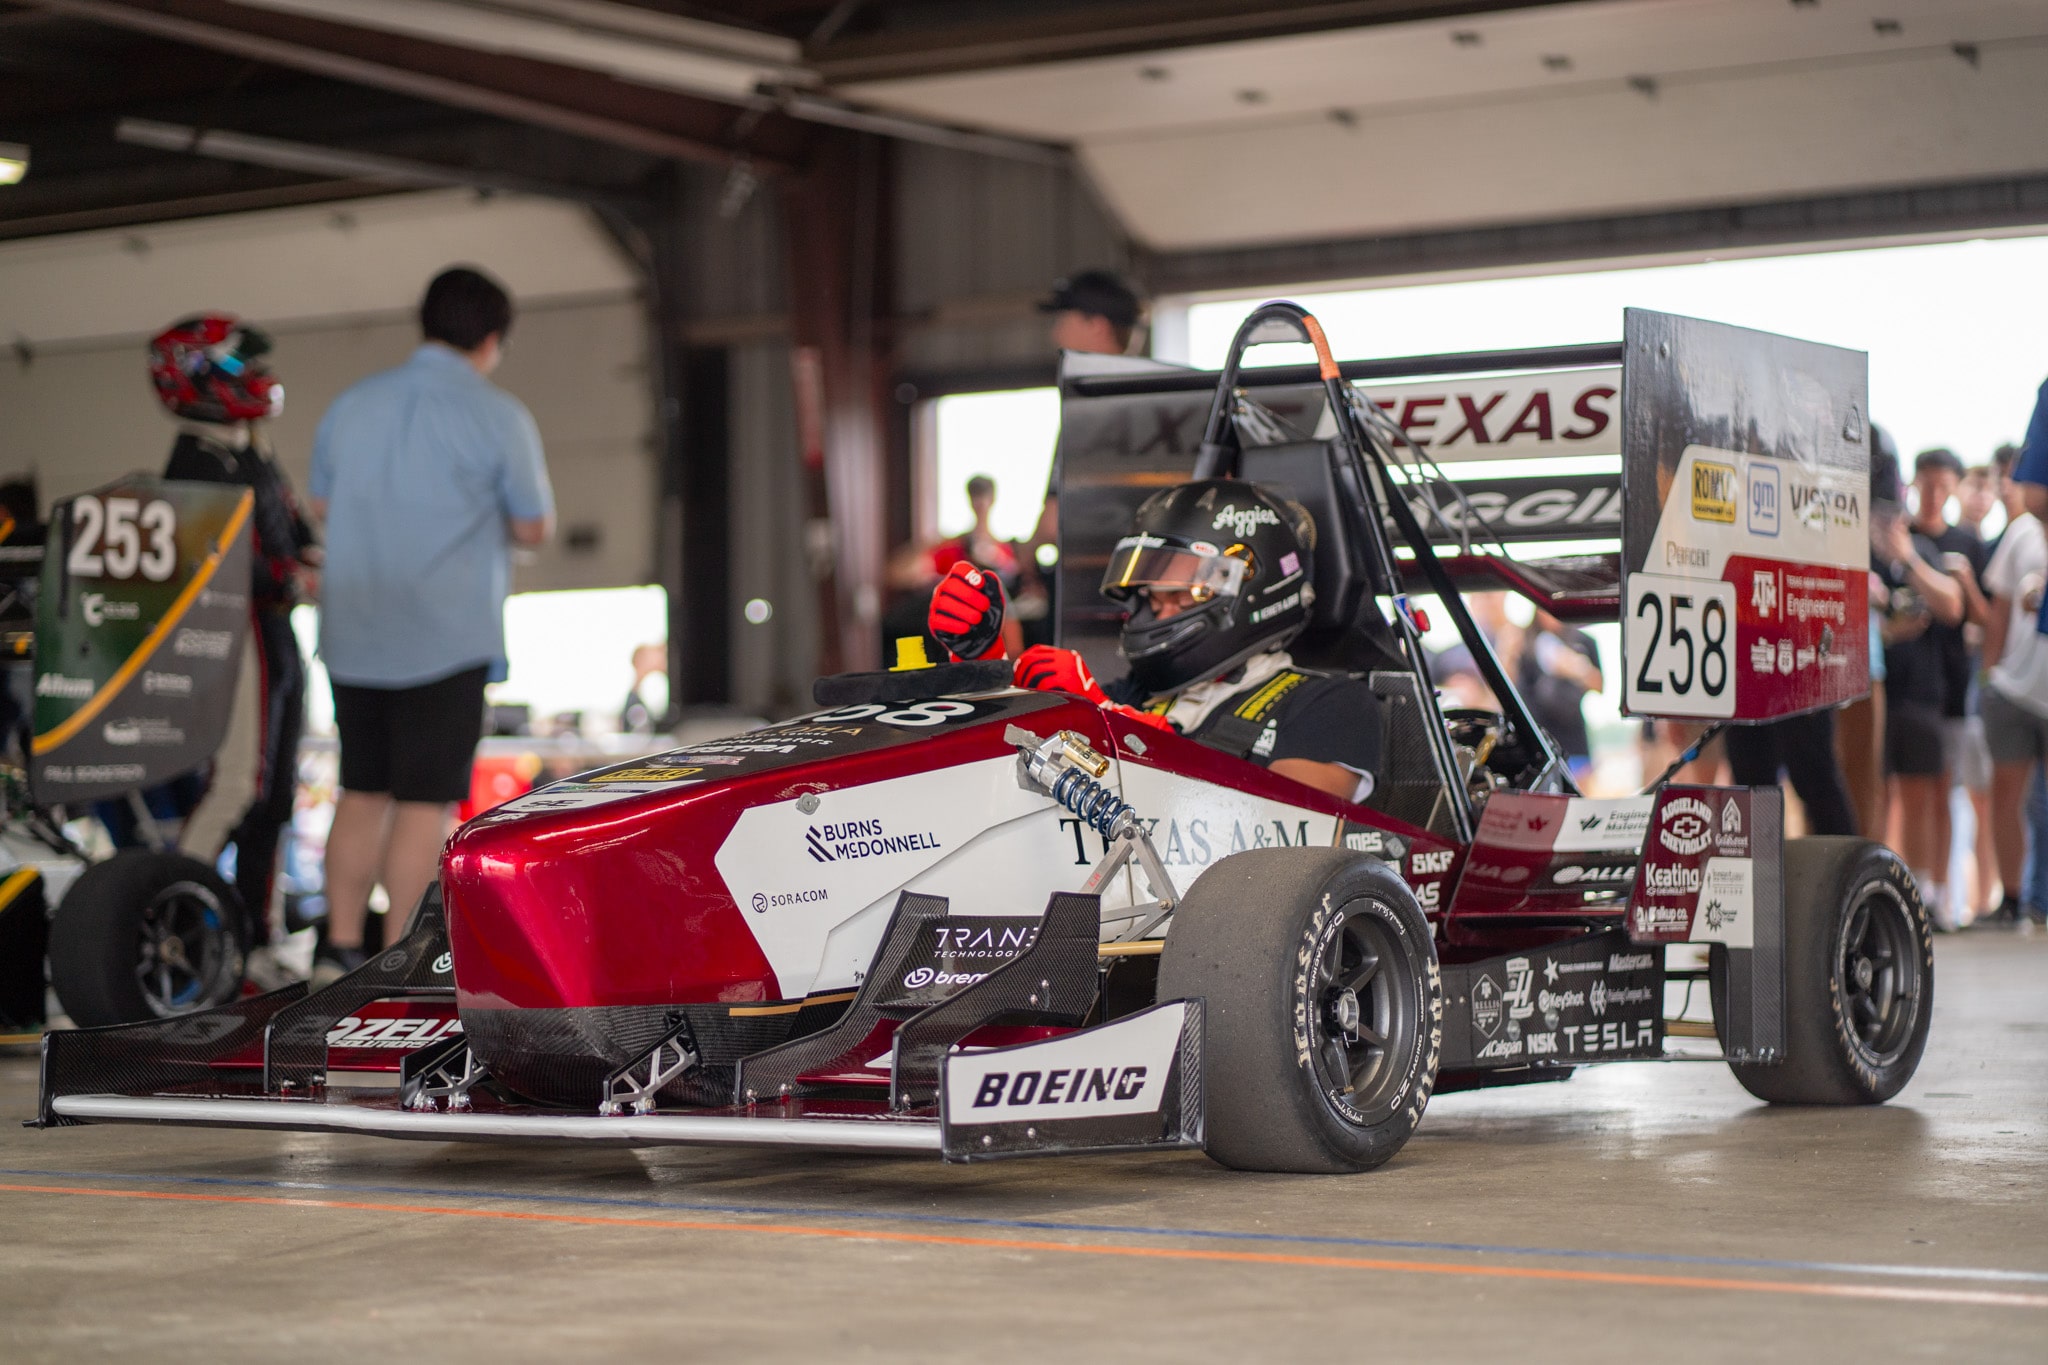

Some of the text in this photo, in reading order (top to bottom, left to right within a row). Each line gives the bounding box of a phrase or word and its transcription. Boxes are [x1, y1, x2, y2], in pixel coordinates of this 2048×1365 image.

[67, 494, 177, 581] 253
[1211, 503, 1281, 538] Aggies
[1786, 592, 1846, 626] Engineering
[1636, 591, 1728, 698] 258
[823, 819, 883, 842] BURNS
[1059, 817, 1212, 866] TXAS
[1660, 828, 1713, 855] CHEVROLET
[1645, 863, 1700, 893] Keating
[771, 889, 829, 907] SORACOM
[1526, 1031, 1559, 1055] NSK
[1562, 1018, 1653, 1054] TESLA
[971, 1066, 1148, 1109] BOEING
